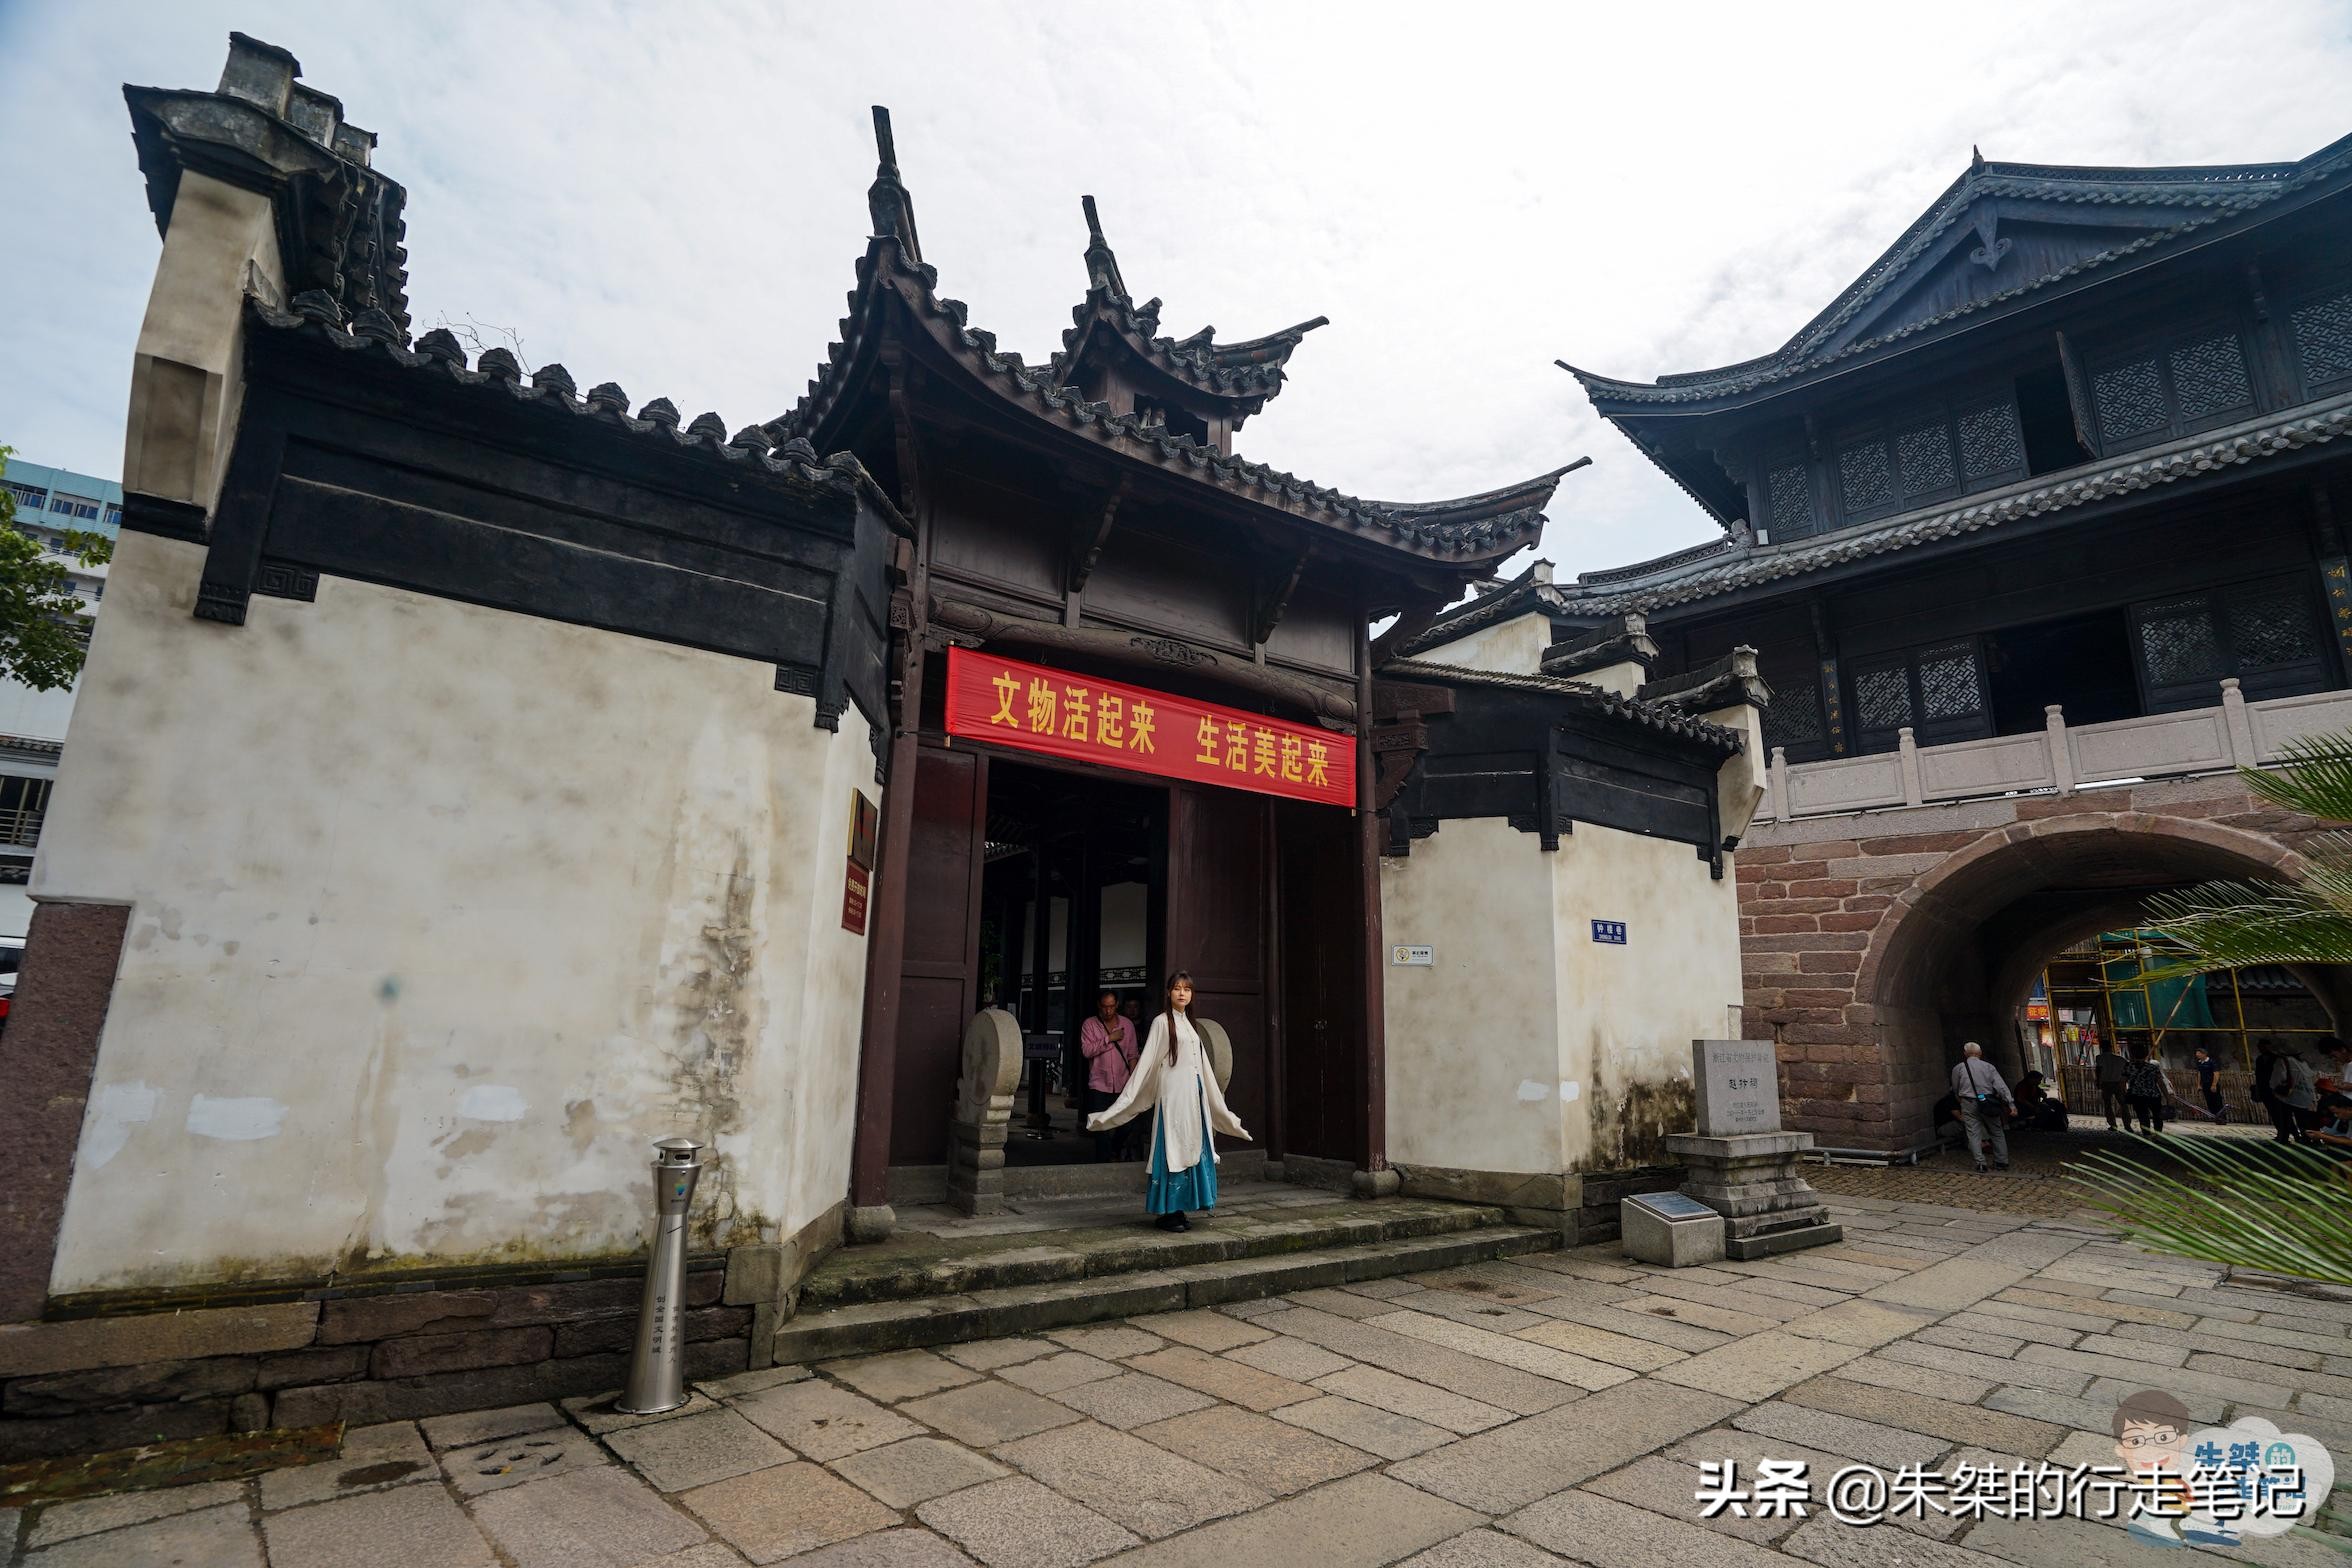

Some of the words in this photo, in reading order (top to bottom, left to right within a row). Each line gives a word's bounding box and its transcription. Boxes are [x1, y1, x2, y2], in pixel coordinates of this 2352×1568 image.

[991, 670, 1156, 755] 文物活起来
[1196, 714, 1329, 787] 生活美起来
